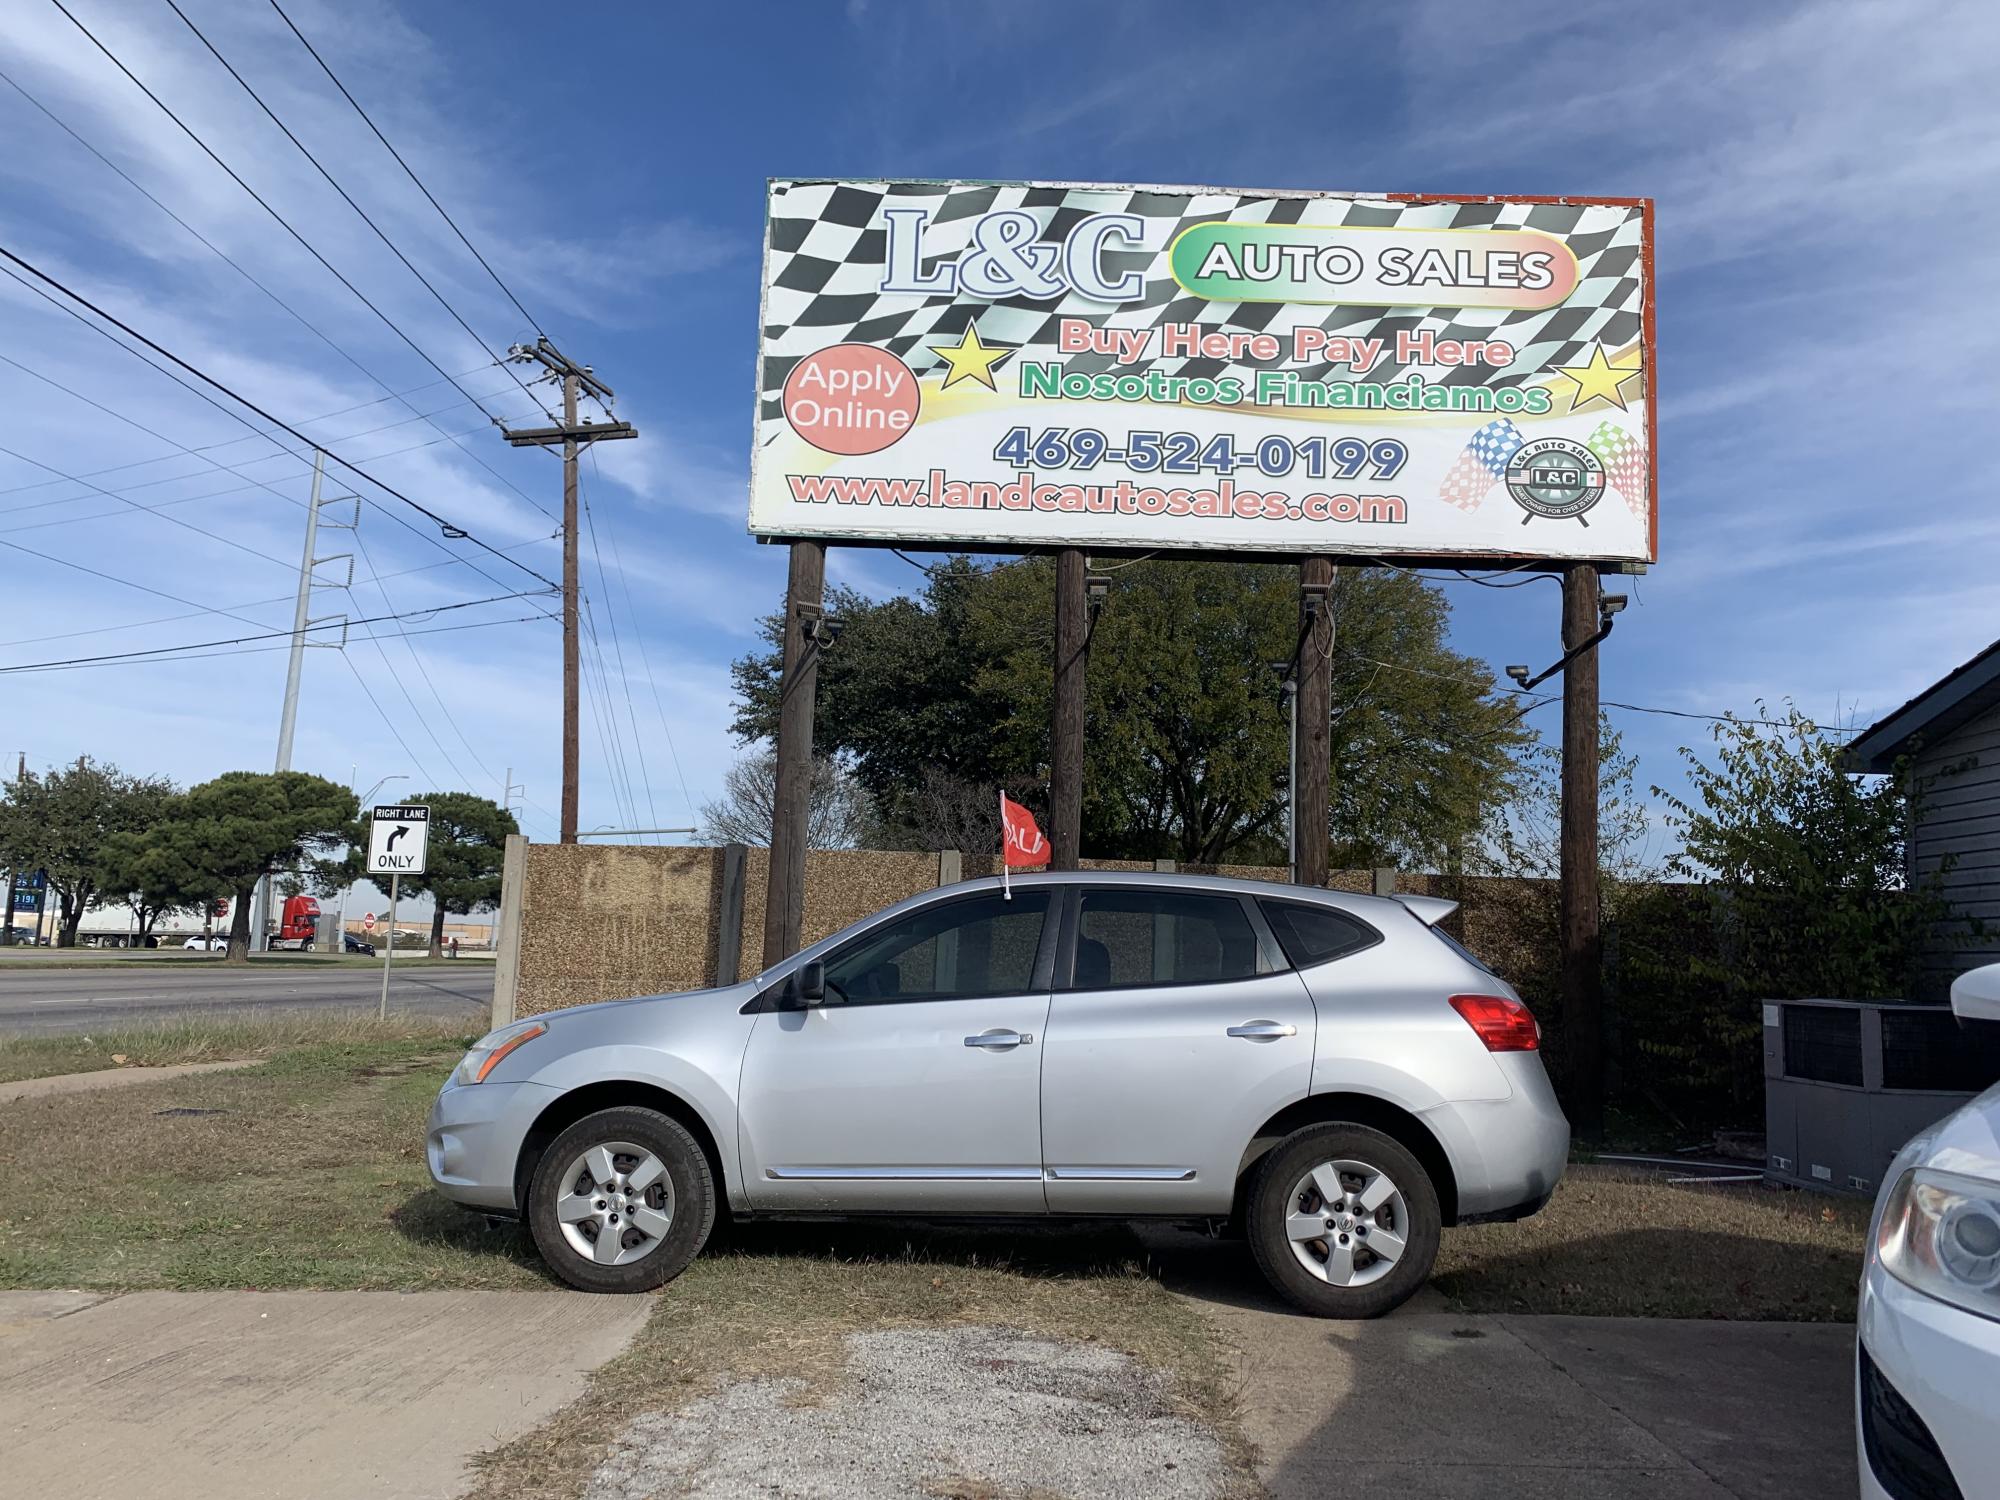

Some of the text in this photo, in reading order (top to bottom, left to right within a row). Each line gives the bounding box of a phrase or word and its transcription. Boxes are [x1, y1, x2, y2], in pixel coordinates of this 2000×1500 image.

[881, 208, 1146, 300] L&C
[1194, 242, 1555, 290] AUTO SALES
[1058, 318, 1515, 371] Buy Here Pay Here
[799, 361, 905, 398] Apply
[1019, 361, 1553, 415] Nosotros Financiamos
[789, 399, 910, 430] Online
[993, 426, 1409, 480] 469-524-0199
[1514, 442, 1597, 469] L&C AUTO SALES
[785, 468, 1408, 524] www.landcautosales.com
[1535, 470, 1576, 485] L&C
[1526, 500, 1546, 512] OWNED
[1562, 504, 1580, 513] OVER
[1583, 488, 1598, 502] YEARS
[376, 808, 426, 819] RIGHT LANE
[378, 855, 415, 868] ONLY
